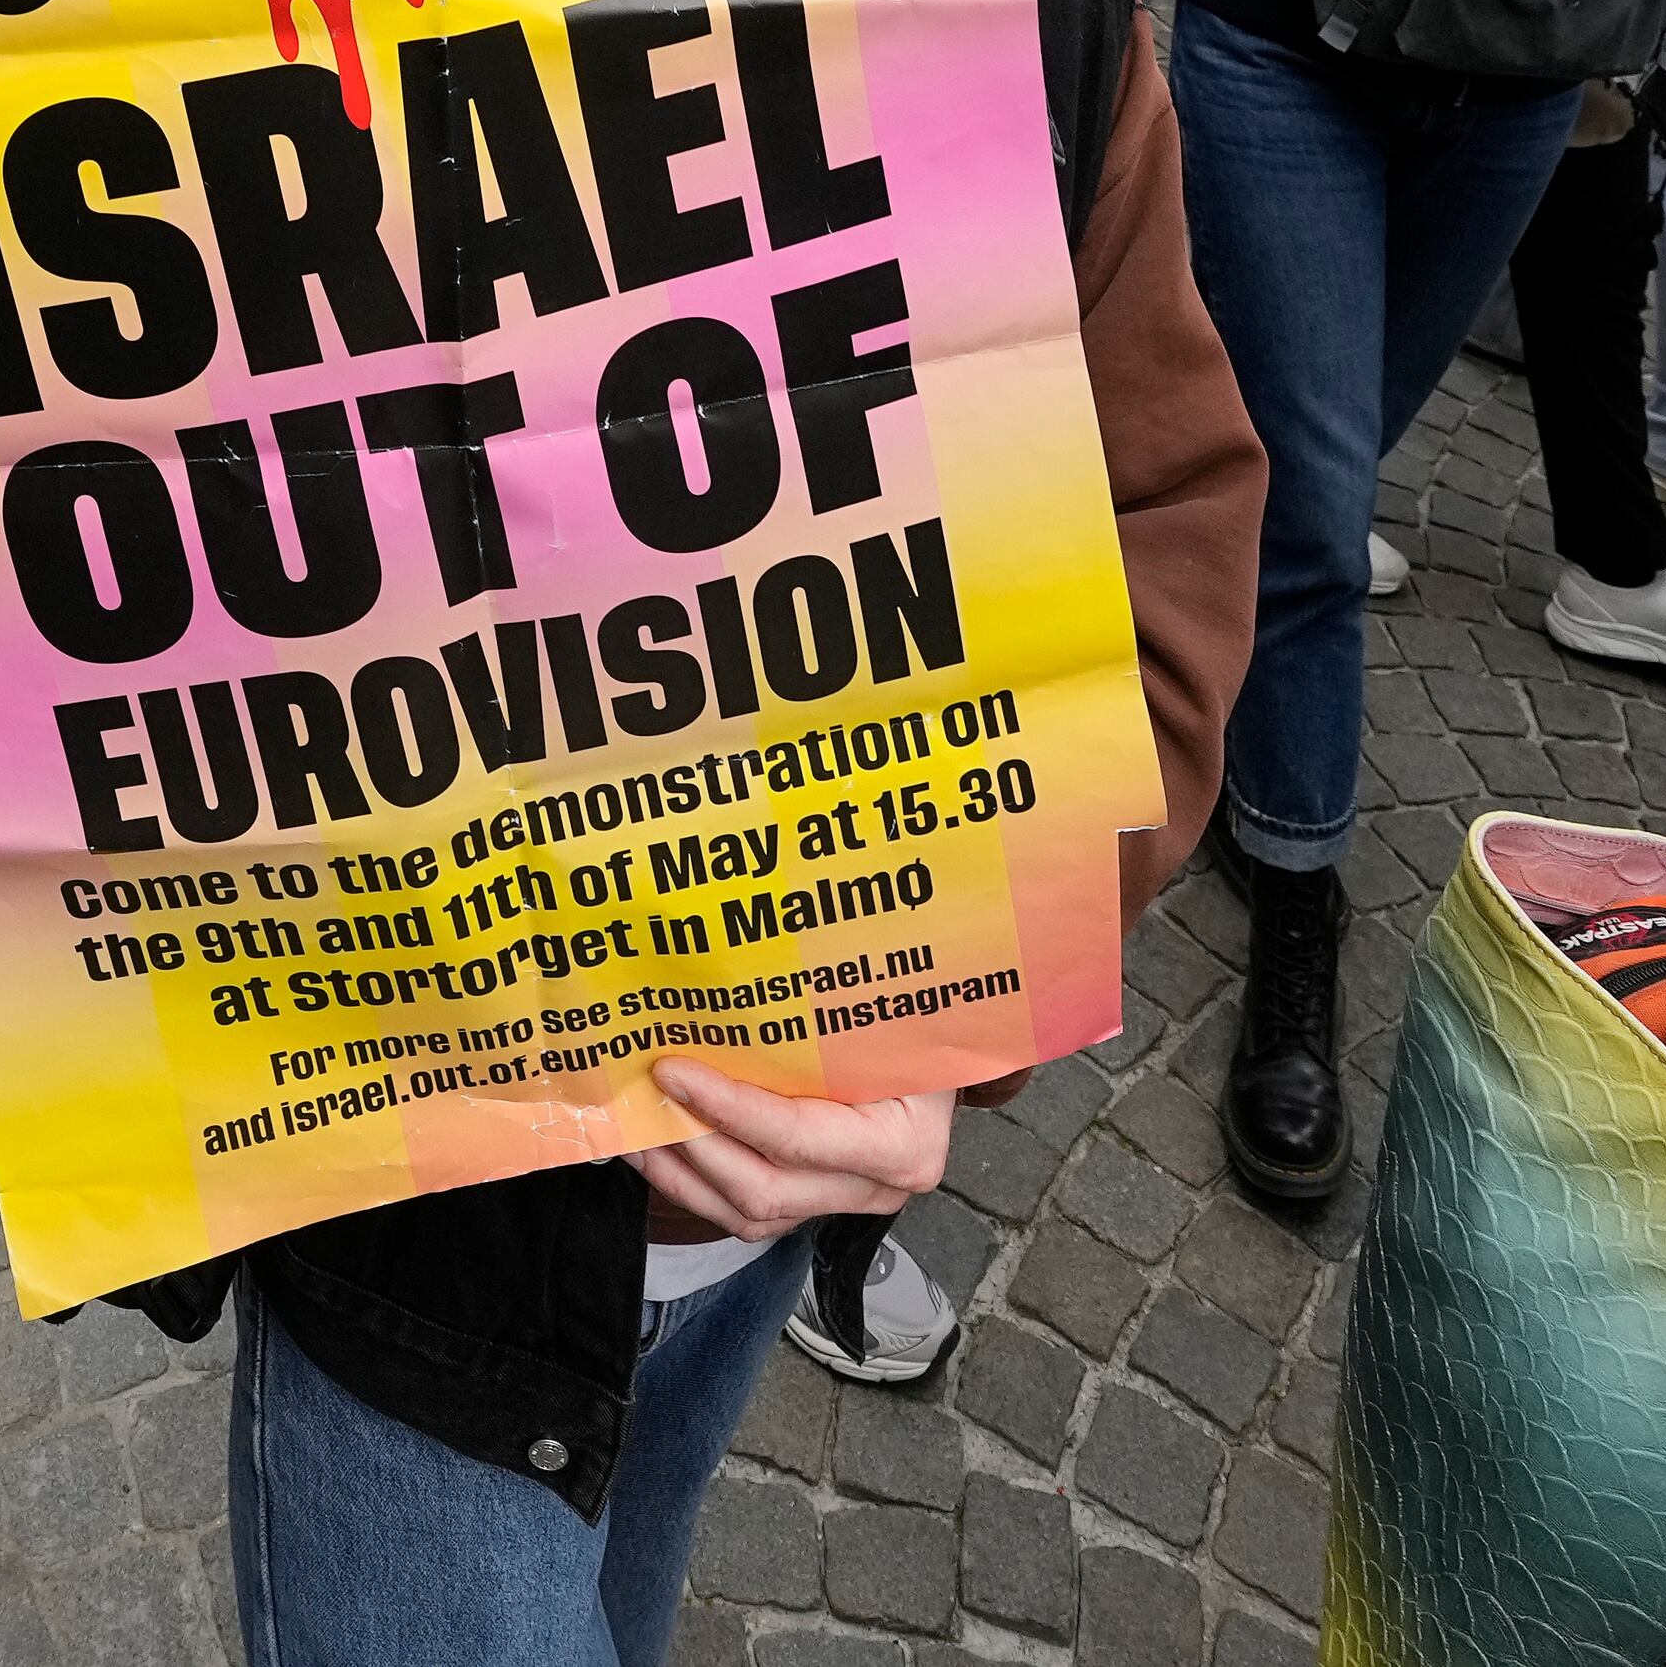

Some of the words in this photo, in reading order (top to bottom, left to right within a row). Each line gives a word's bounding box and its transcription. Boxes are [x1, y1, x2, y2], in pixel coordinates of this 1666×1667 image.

[2, 370, 527, 666] OUT
[595, 257, 919, 554] OF
[52, 516, 967, 856] EUROVISION
[74, 932, 185, 983] the
[195, 917, 306, 964] 9th
[315, 906, 435, 955] and
[442, 864, 559, 941] 11th
[569, 849, 634, 908] of
[647, 822, 780, 895] May
[797, 798, 867, 861] at
[872, 756, 1037, 842] 15.30
[246, 862, 319, 901] to
[327, 846, 439, 896] the
[450, 711, 931, 869] demonstration
[941, 688, 1021, 748] on
[210, 975, 280, 1027] at
[647, 912, 710, 957] in
[720, 855, 935, 948] Malmø
[269, 1044, 337, 1087] For
[343, 1032, 451, 1069] more
[456, 1017, 534, 1053] info
[540, 1002, 611, 1034] see
[617, 942, 935, 1017] stoppaisrael.nu
[203, 1106, 276, 1156] and
[281, 1019, 751, 1137] israel.out.of.eurovision
[758, 1014, 808, 1046] on
[814, 967, 1021, 1037] Instagram
